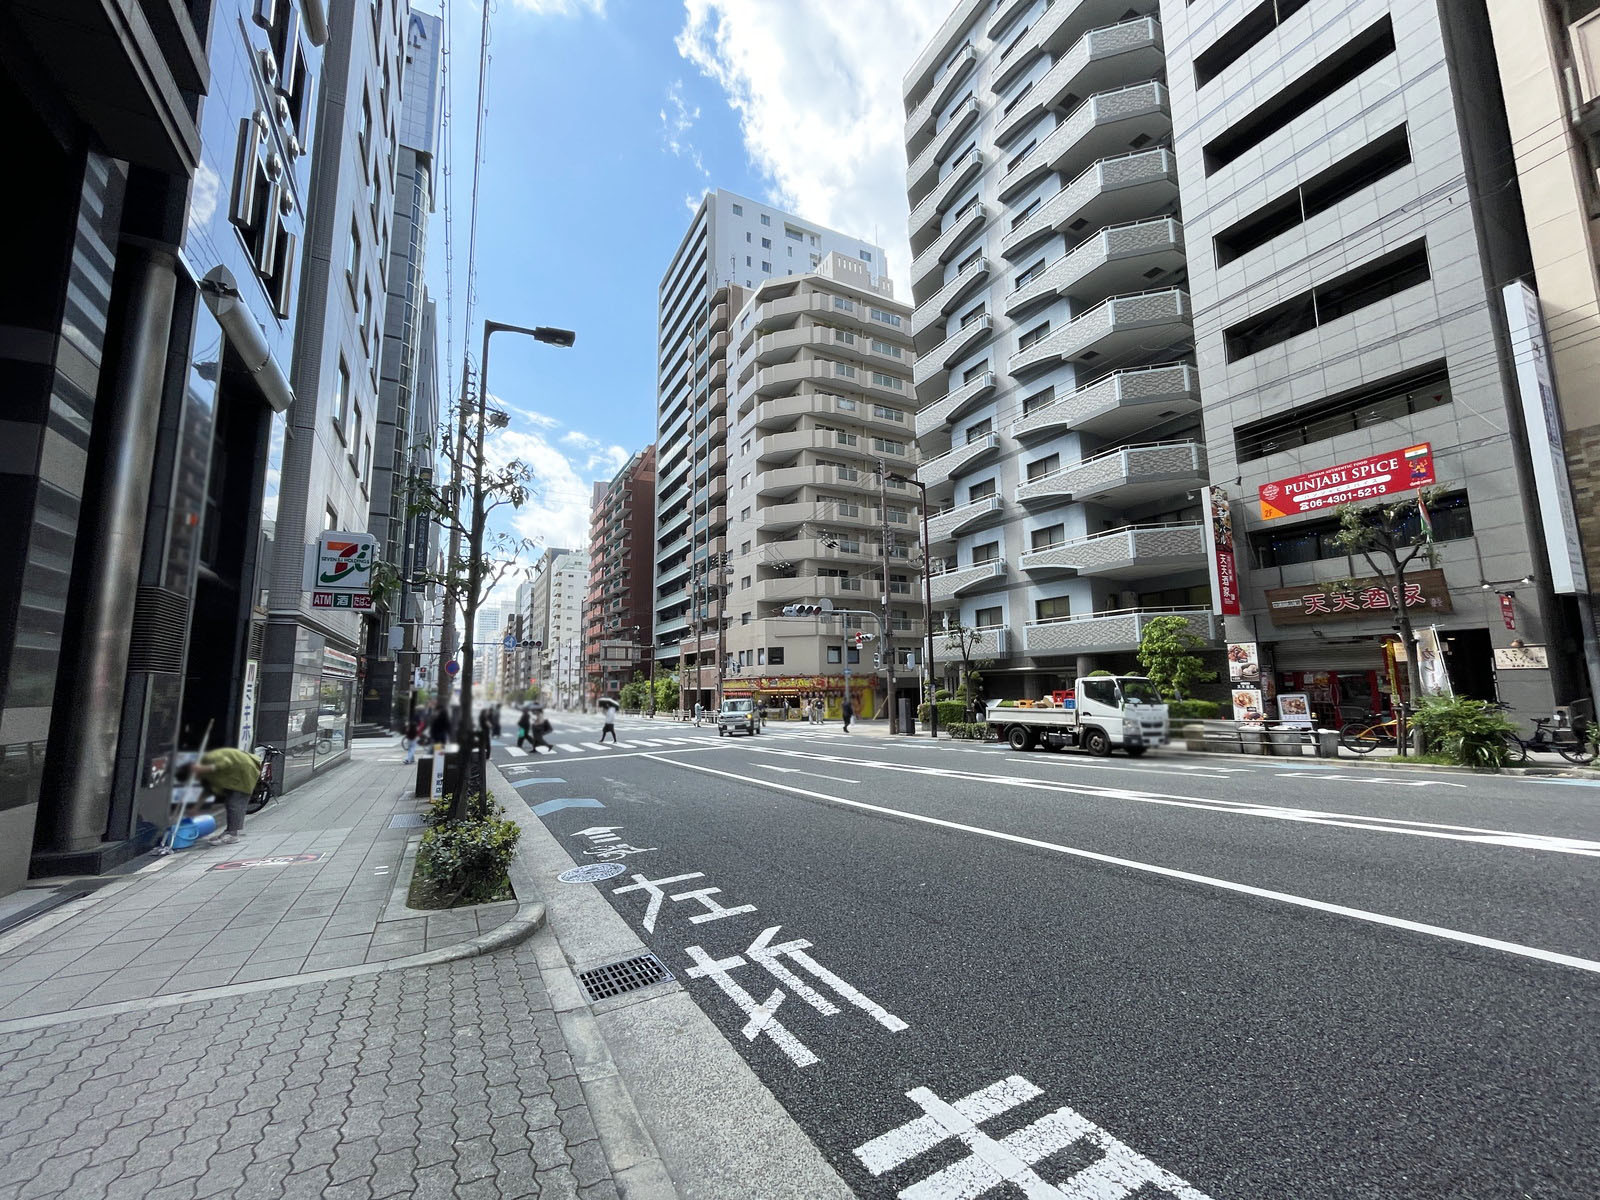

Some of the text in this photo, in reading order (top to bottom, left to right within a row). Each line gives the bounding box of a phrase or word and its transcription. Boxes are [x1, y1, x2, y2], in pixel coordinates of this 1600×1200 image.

[1284, 471, 1347, 496] PUNJABI
[1352, 458, 1399, 479] SPICE
[1309, 485, 1387, 508] 06-4301-5213
[1264, 508, 1273, 518] 2F
[1219, 553, 1231, 598] 天天酒家
[314, 594, 331, 605] ATM
[336, 595, 349, 606] 酒
[353, 596, 371, 606] たばこ
[1302, 582, 1426, 615] 天天酒家
